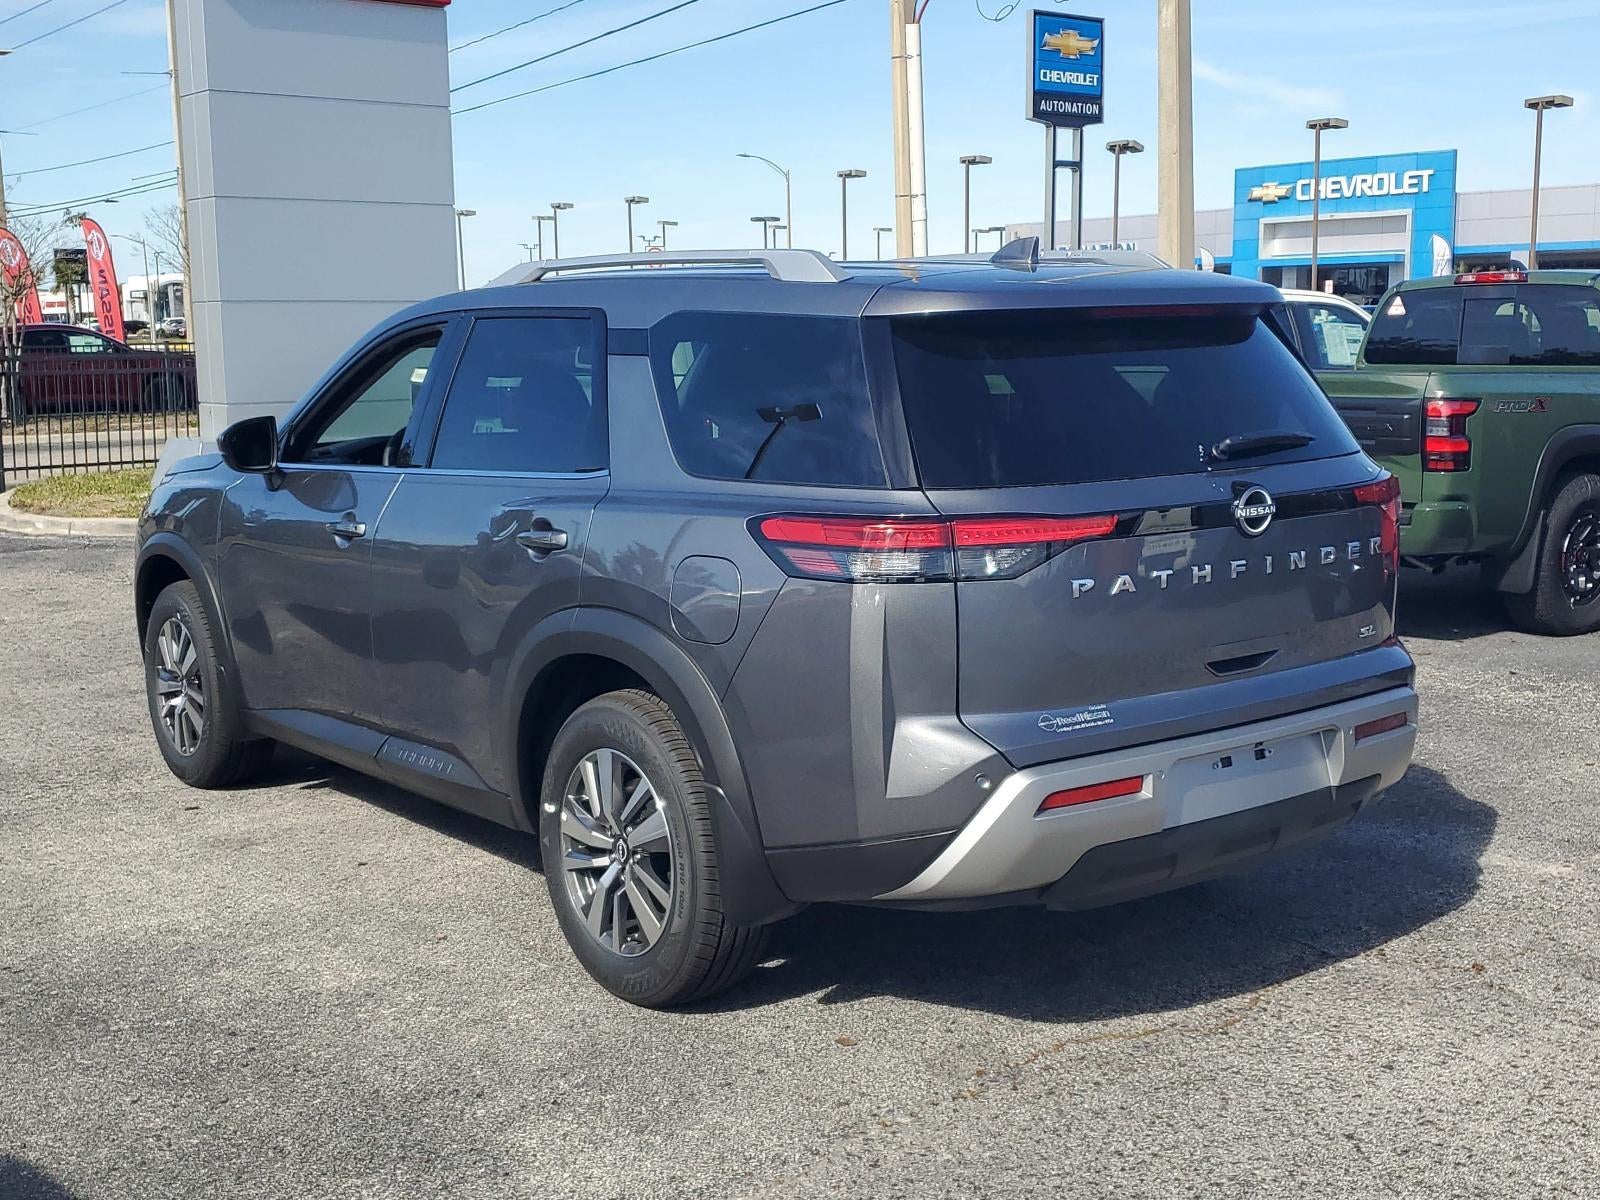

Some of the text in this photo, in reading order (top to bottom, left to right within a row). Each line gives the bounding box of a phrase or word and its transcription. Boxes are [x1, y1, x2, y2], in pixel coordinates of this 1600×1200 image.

[1040, 69, 1099, 86] CHEVROLET
[1040, 99, 1099, 115] AUTONATION
[1296, 169, 1434, 201] CHEVROLET
[1237, 505, 1276, 518] NISSAN
[1070, 536, 1383, 599] PATHFINDER
[1358, 624, 1377, 638] SL
